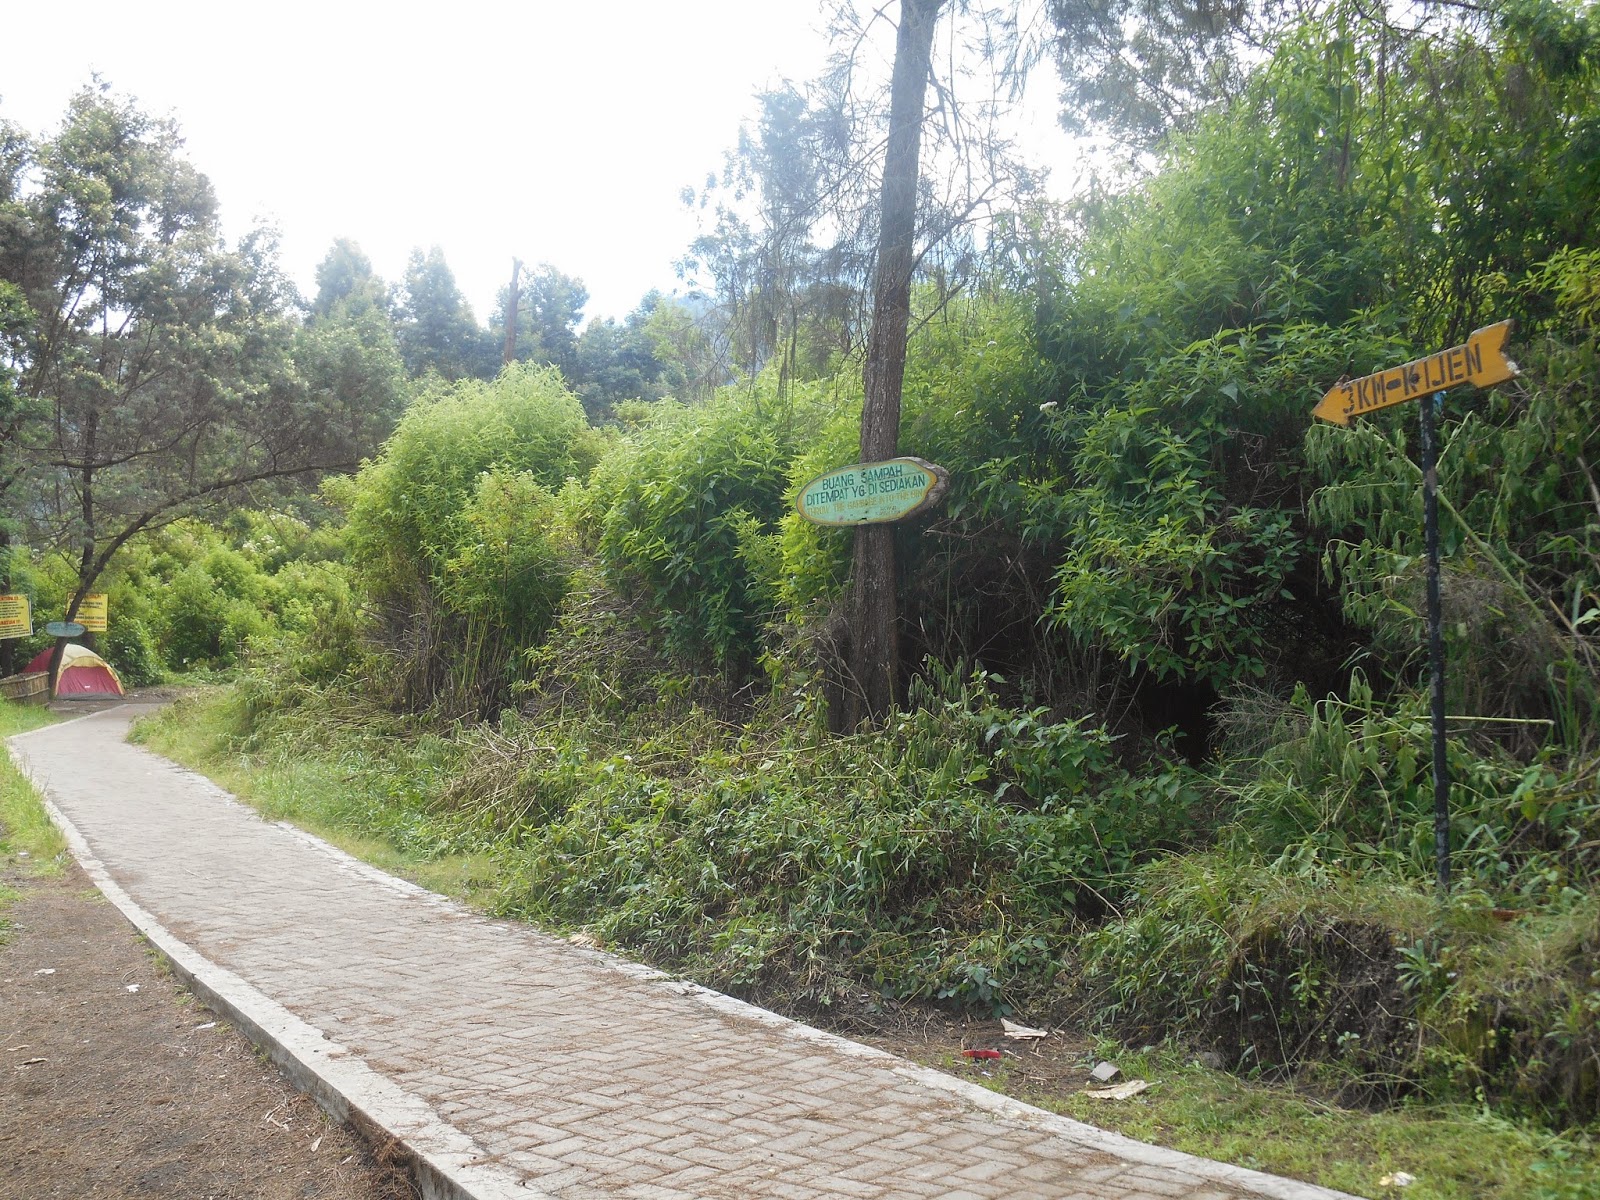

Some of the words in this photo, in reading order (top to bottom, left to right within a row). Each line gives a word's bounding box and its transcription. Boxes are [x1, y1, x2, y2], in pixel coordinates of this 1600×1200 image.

[806, 487, 849, 506] DITEMPAT
[868, 482, 877, 496] DI
[879, 474, 925, 493] SEDIAKAN
[822, 475, 854, 491] BUANG
[860, 465, 903, 483] SAMPAH
[847, 498, 877, 510] GARBAGE
